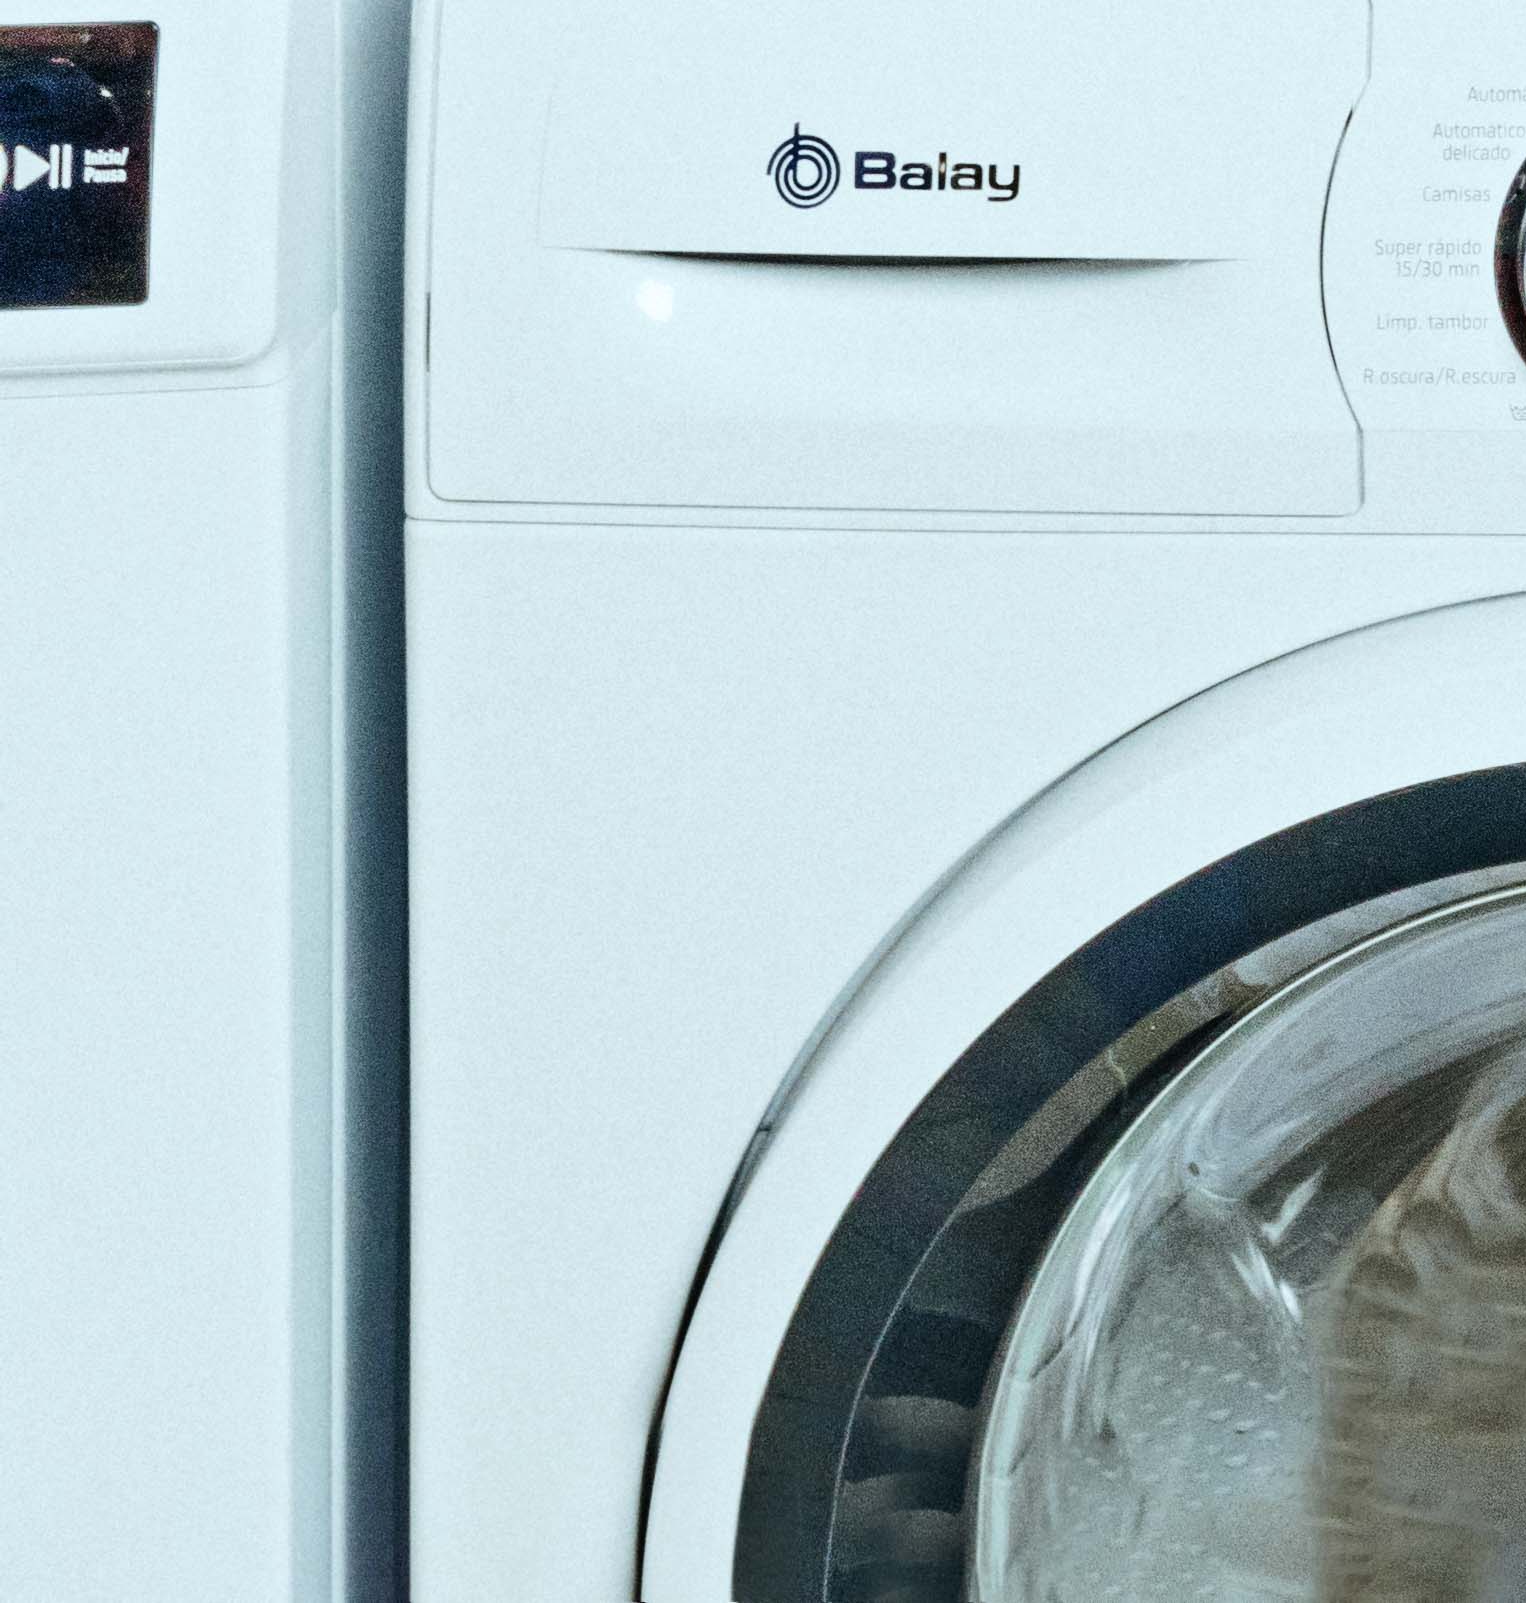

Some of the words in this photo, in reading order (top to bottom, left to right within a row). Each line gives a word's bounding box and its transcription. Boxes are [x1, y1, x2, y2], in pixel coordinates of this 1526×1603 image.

[84, 145, 129, 166] Inicio/
[1442, 144, 1511, 162] delicado
[83, 167, 128, 184] Pausa
[853, 150, 1022, 203] Balay
[1422, 186, 1492, 203] Camisas
[1374, 239, 1424, 259] Super
[1429, 237, 1482, 259] rápido
[1395, 259, 1442, 278] 15/30
[1447, 260, 1480, 277] min
[1376, 314, 1422, 333] Limp.
[1428, 314, 1489, 331] tambor
[1362, 367, 1516, 386] R.oscura/R.escura
